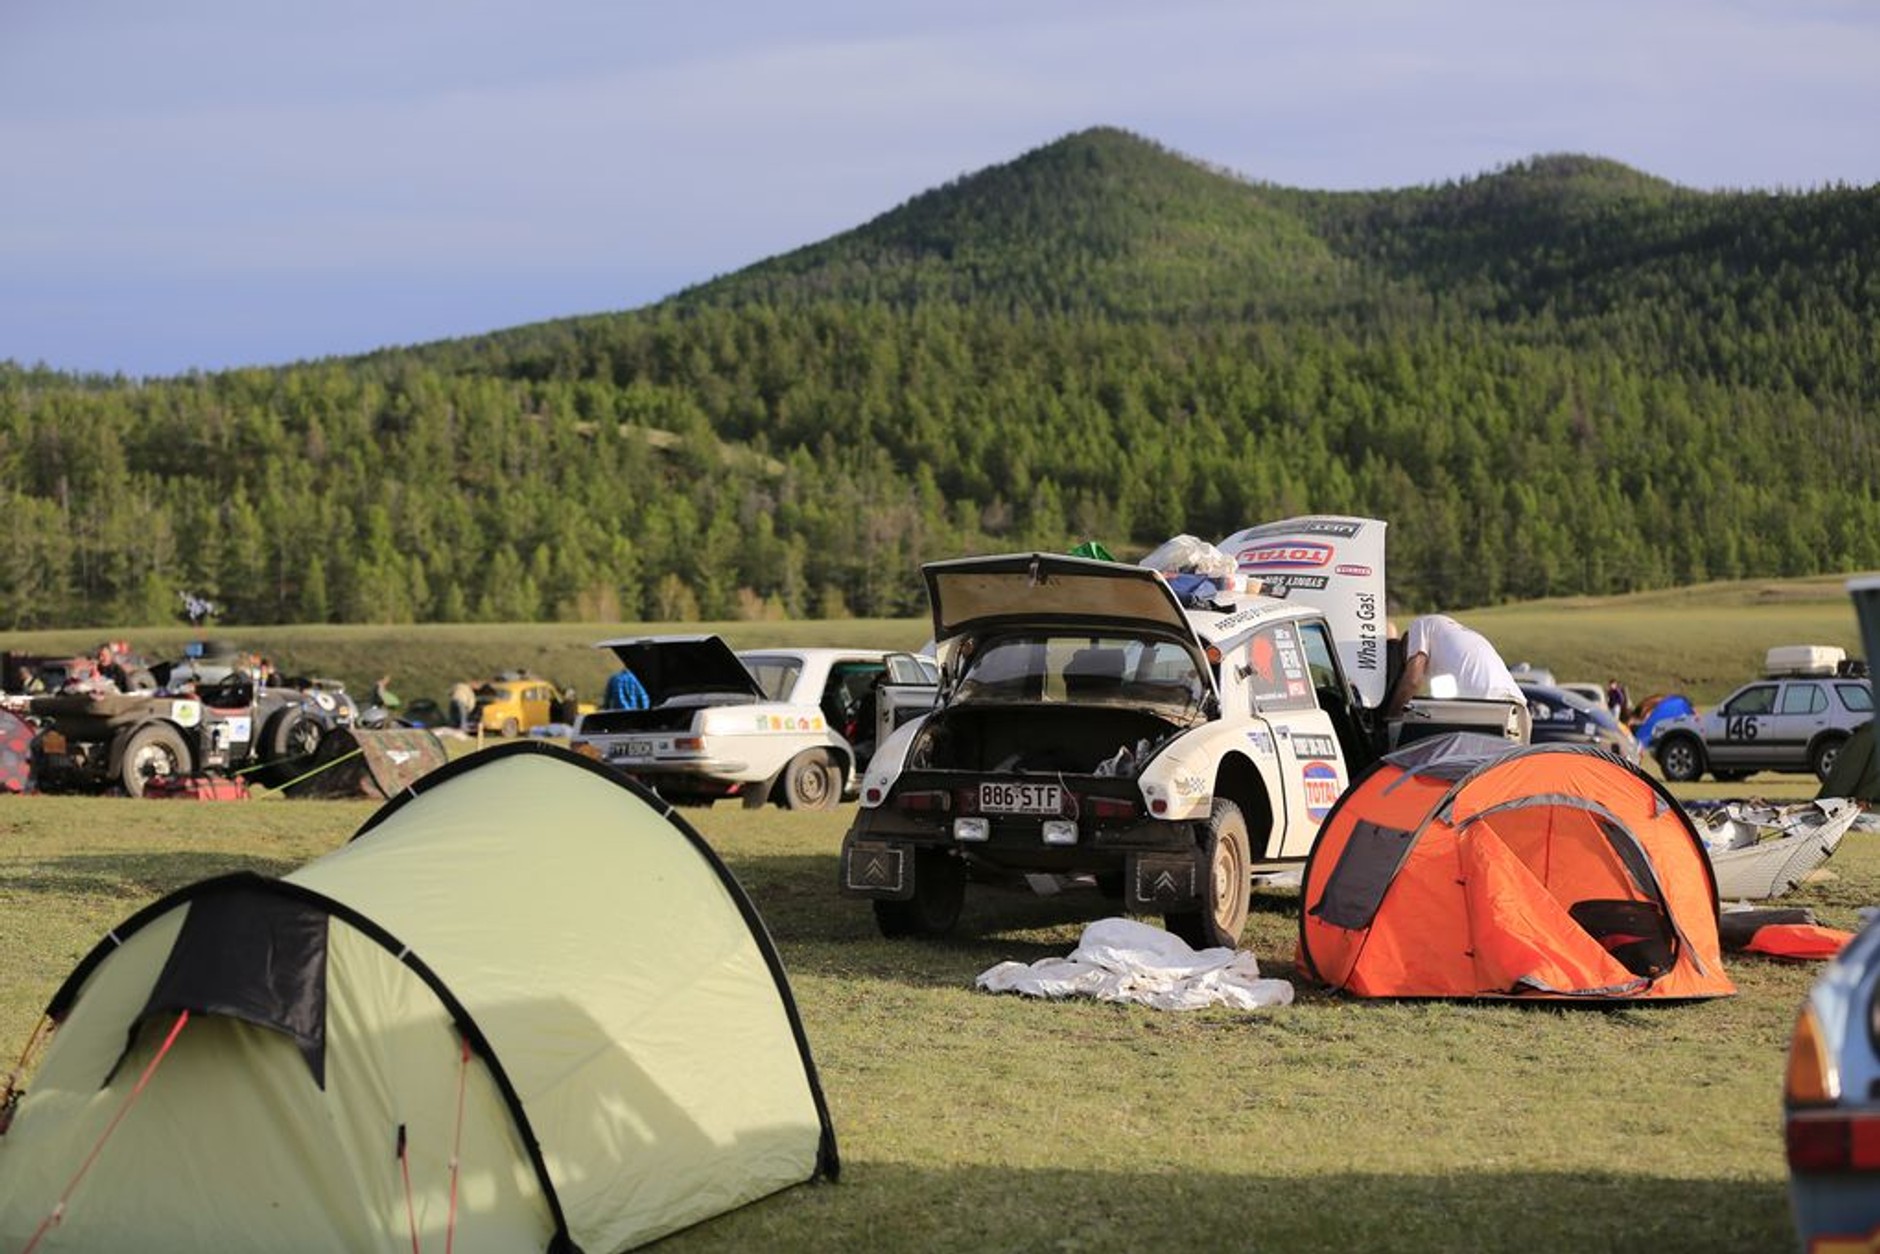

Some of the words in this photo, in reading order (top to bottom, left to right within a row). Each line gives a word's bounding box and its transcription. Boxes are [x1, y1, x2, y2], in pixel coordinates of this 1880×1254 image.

[1243, 549, 1323, 562] TOTAL
[1285, 576, 1325, 588] SYDNEY
[1355, 592, 1375, 620] Gas!
[1360, 623, 1375, 632] a
[1356, 634, 1377, 670] What
[1726, 715, 1757, 741] 146
[1306, 781, 1339, 804] TOTAL
